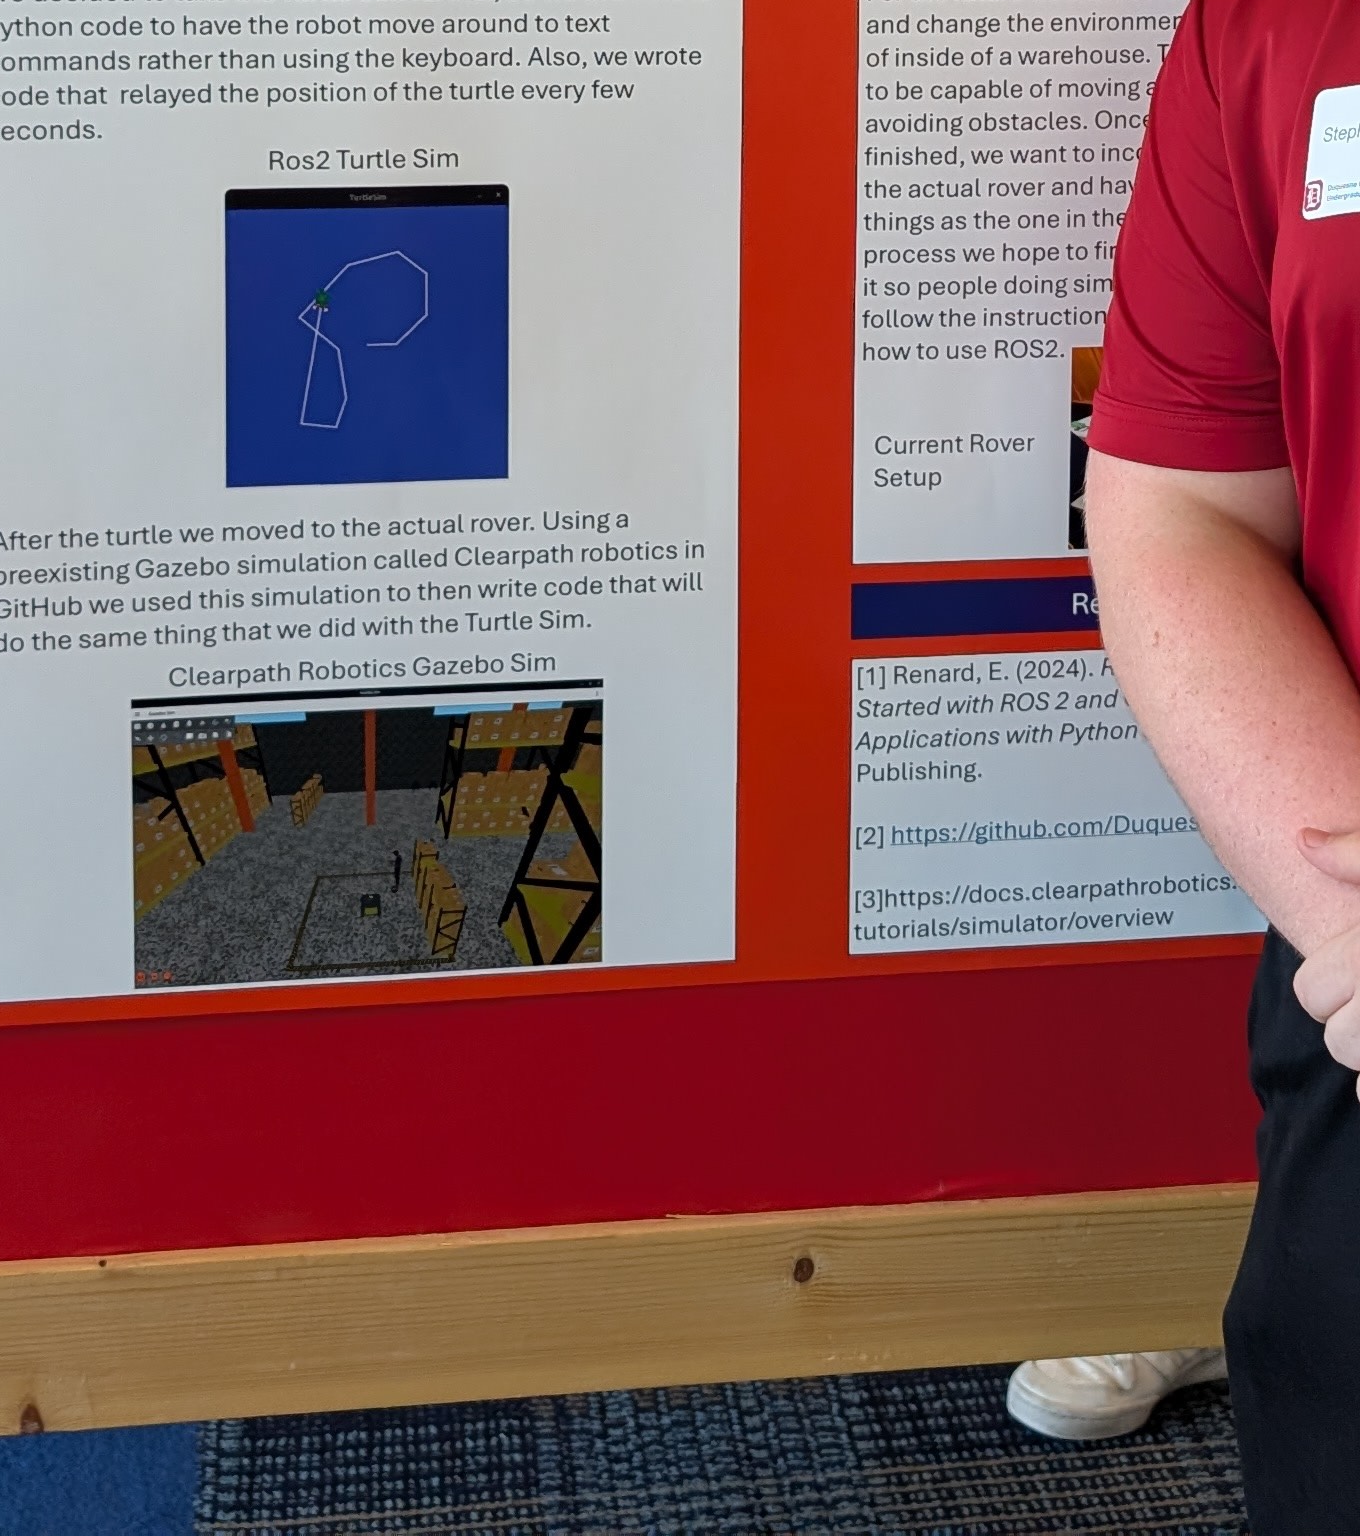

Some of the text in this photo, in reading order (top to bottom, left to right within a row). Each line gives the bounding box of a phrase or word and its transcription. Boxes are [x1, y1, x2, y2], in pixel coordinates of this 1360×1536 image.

[269, 148, 459, 171] Ros2 Turtle Sim
[862, 338, 1065, 362] how to use ROS2.
[874, 433, 1036, 456] Current Rover
[873, 467, 942, 491] Setup
[135, 556, 231, 579] Gazebo
[236, 551, 367, 575] simulation
[373, 547, 448, 570] called
[454, 543, 574, 570] Clearpath
[580, 540, 678, 563] robotics
[684, 539, 705, 560] in
[168, 652, 556, 688] Clearpath Robotics Gazebo Sim
[857, 665, 886, 692] [1]
[893, 662, 982, 685] Renard,
[989, 660, 1009, 681] E.
[1016, 657, 1094, 685] (2024).
[856, 688, 1120, 719] Started with ROS 2 and
[855, 720, 1138, 755] Applications with Python
[856, 761, 983, 783] Publishing.
[855, 814, 1197, 851] [2] https://github.com/Duques
[853, 909, 1174, 942] tutorials/simulator/overview
